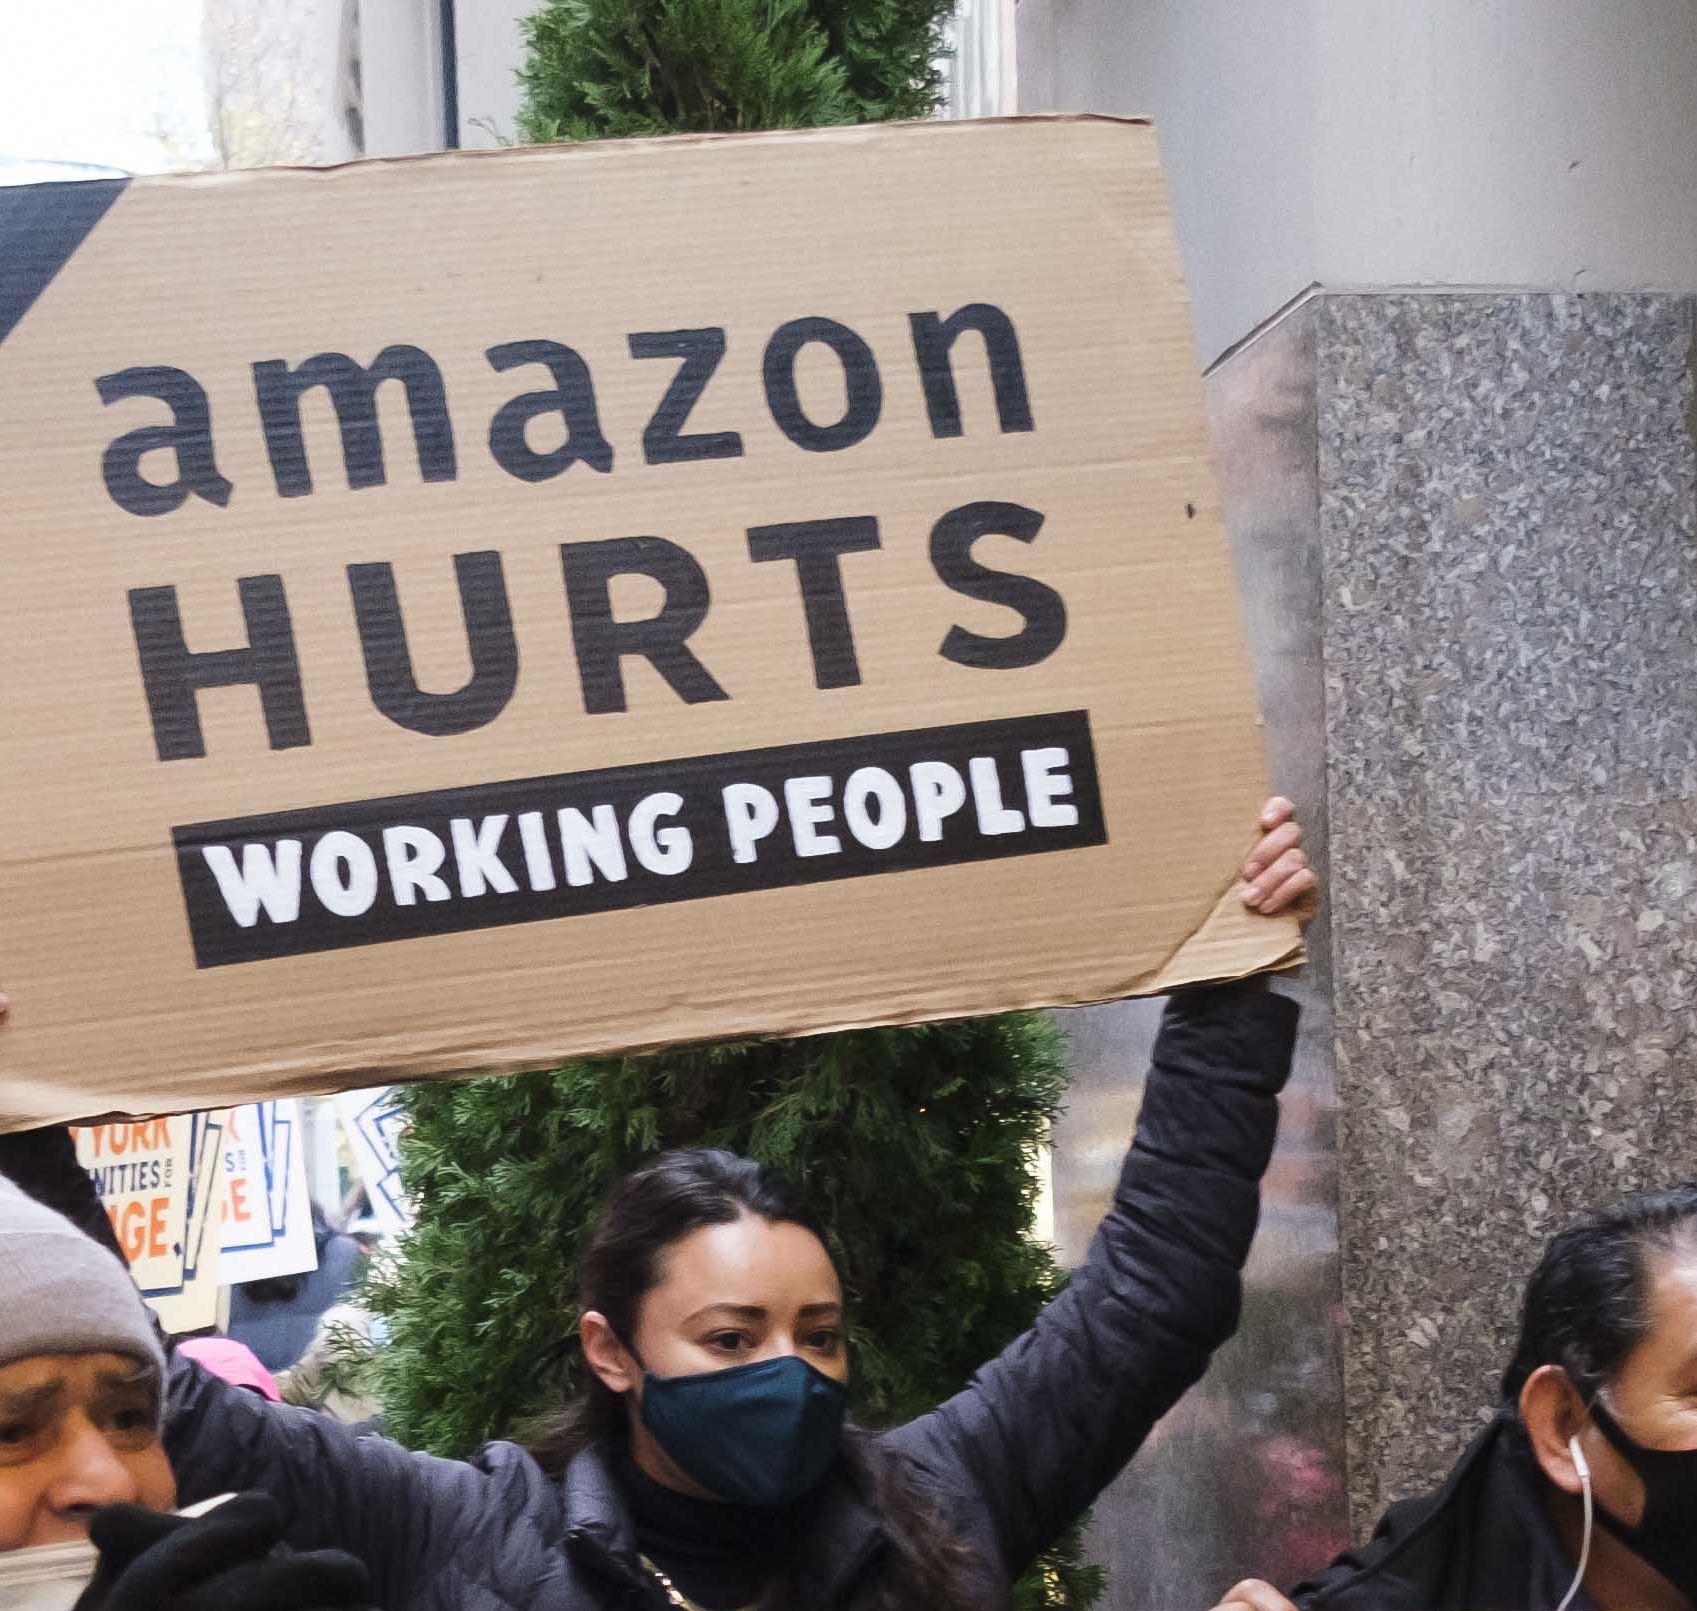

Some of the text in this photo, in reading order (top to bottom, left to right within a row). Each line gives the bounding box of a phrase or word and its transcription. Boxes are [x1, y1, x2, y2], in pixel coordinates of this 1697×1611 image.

[93, 302, 1035, 517] amazon
[126, 501, 1068, 761] HURTS
[201, 747, 1081, 928] WORKING PEOPLE
